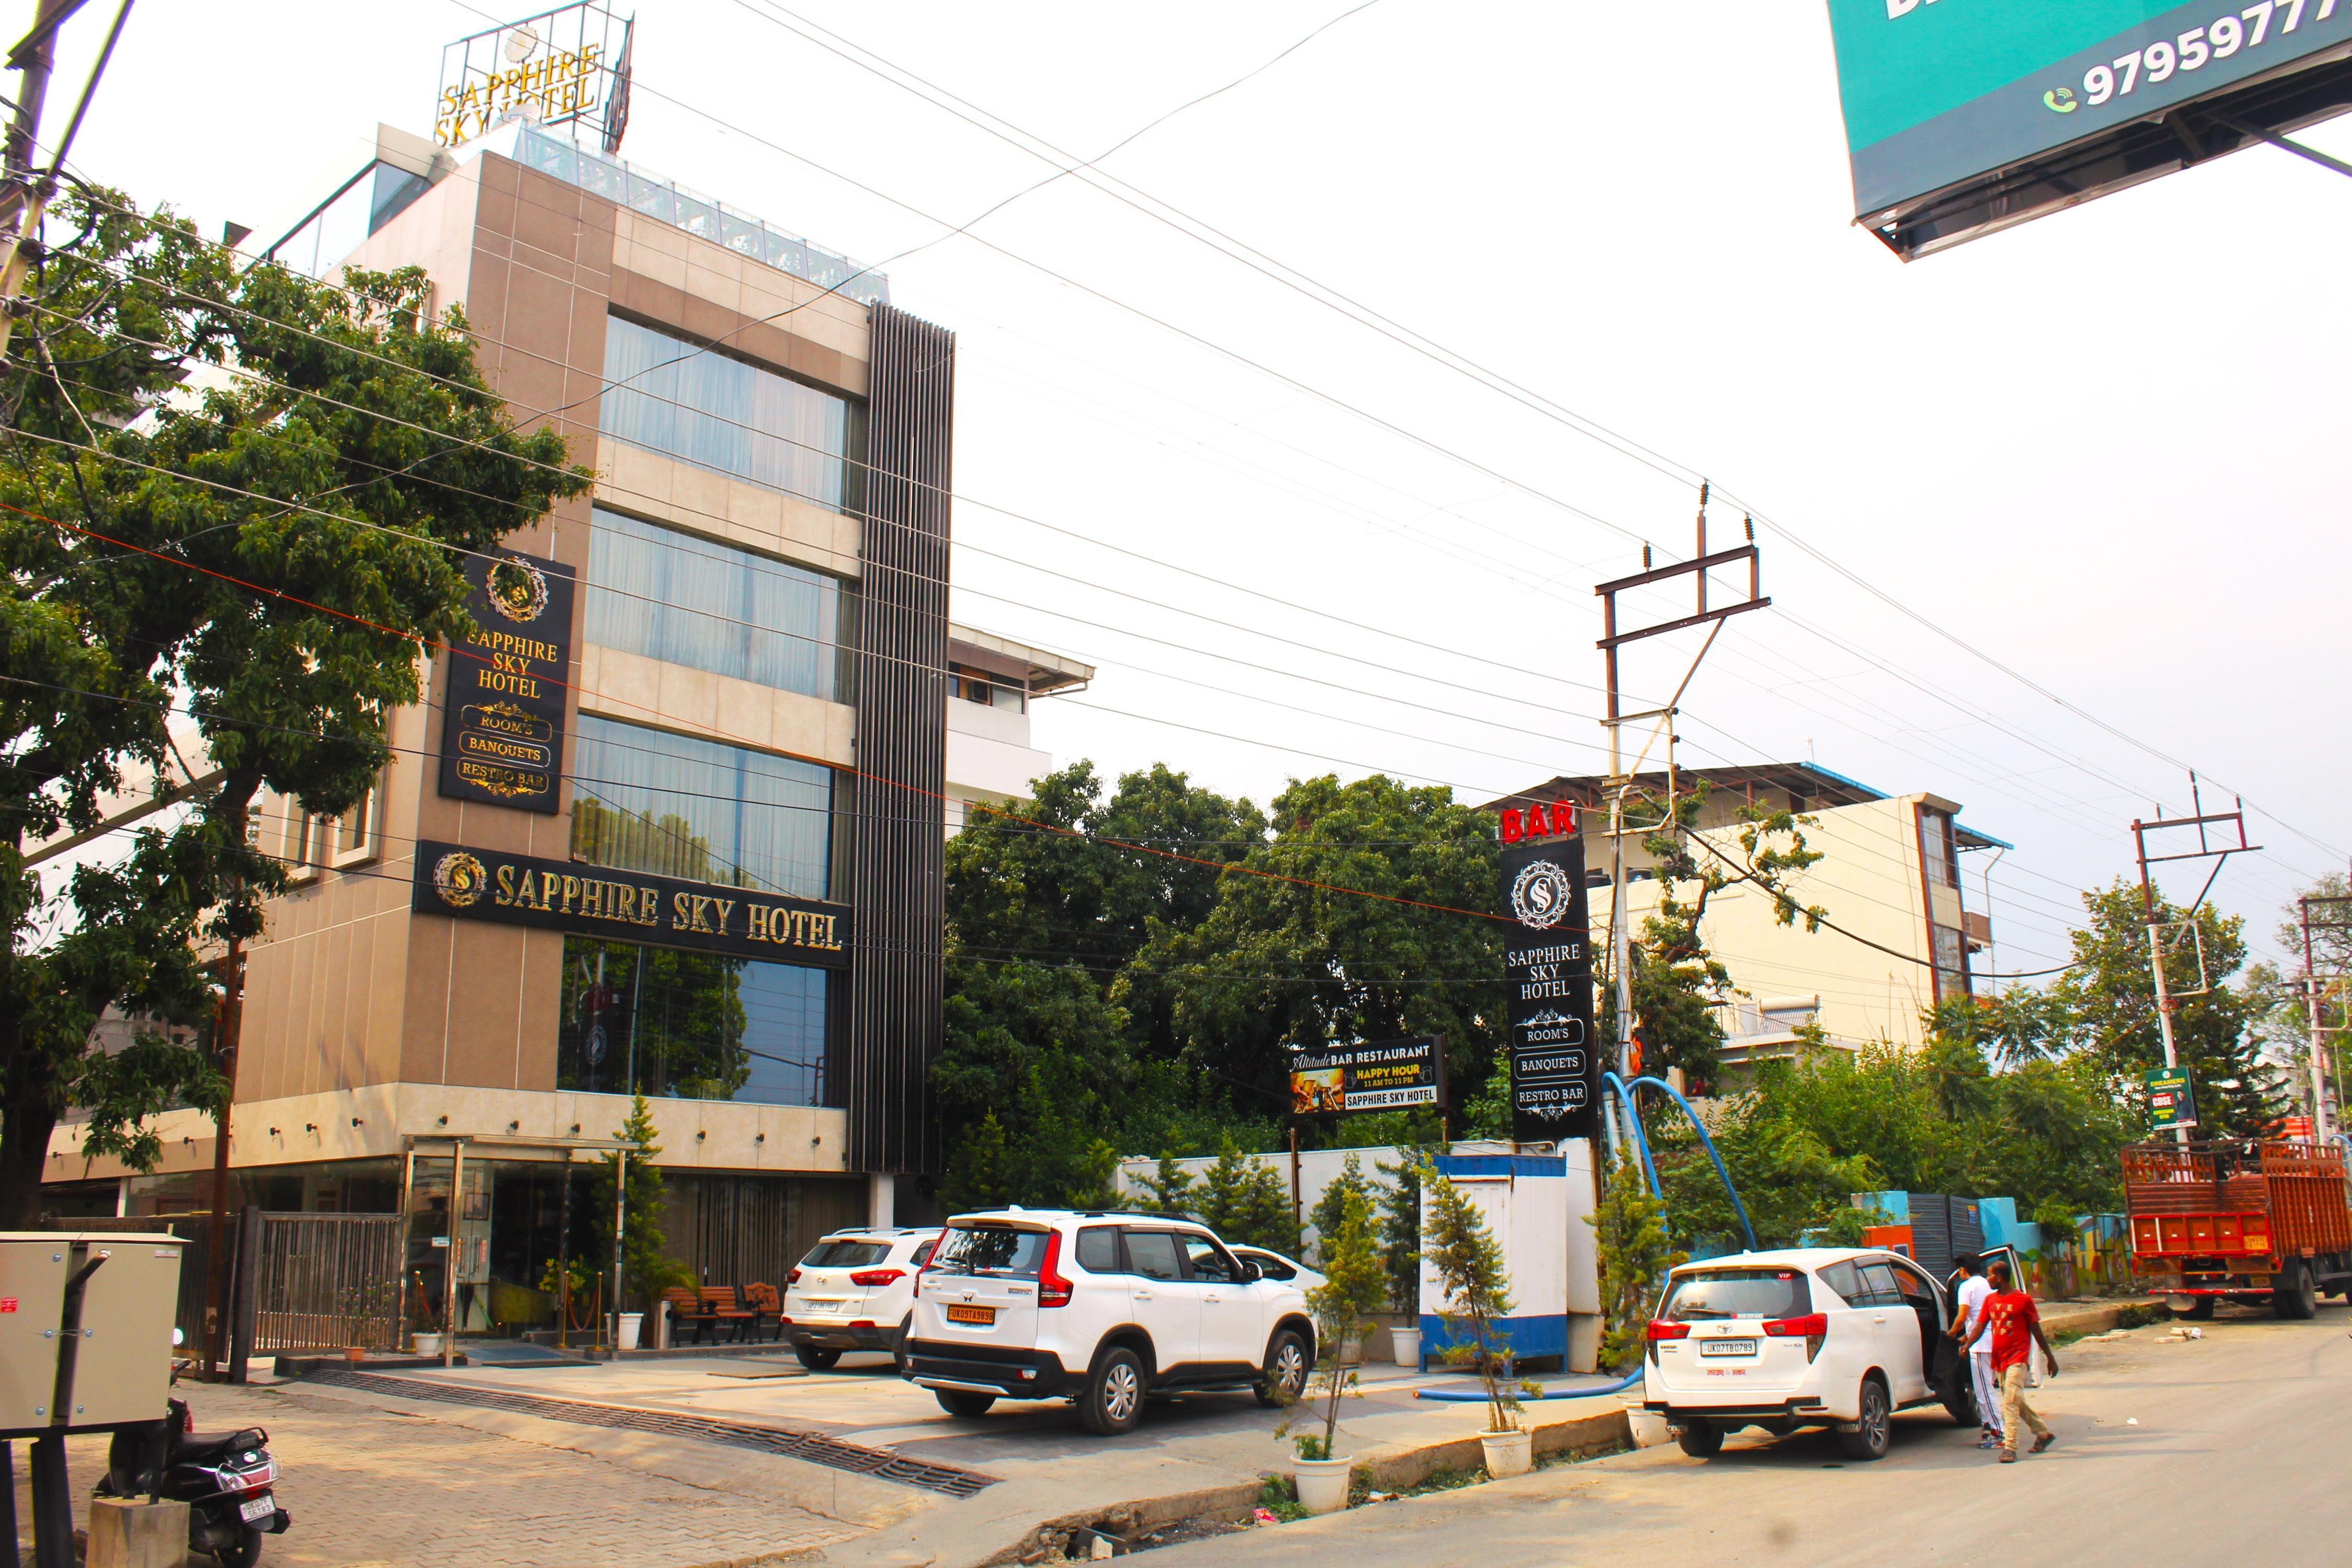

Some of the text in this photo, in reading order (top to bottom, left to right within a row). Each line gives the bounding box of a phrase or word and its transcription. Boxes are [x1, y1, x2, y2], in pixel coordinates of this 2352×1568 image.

[442, 43, 599, 116] SAPPHIRE
[434, 106, 492, 147] SKY
[493, 653, 531, 676] SKY
[478, 669, 540, 699] HOTEL
[481, 716, 533, 735] ROOM'S
[469, 737, 540, 760] BANQUETS
[462, 763, 543, 787] RESTRO BAR
[1502, 800, 1575, 844] BAR
[495, 864, 659, 926] SAPPHIRE
[673, 892, 735, 936] SKY
[747, 904, 843, 951] HOTEL
[1508, 944, 1580, 966] SAPPHIRE
[1530, 964, 1559, 981] SKY
[1521, 981, 1570, 999] HOTEL
[1527, 1028, 1569, 1041] ROOM'S
[1289, 1045, 1429, 1072] Altitude BAR RESTAURANT
[1521, 1057, 1578, 1071] BANQUETS
[1357, 1064, 1420, 1079] HAPPY HOUR
[1347, 1090, 1434, 1106] SAPPHIRE SKY HOTEL
[1519, 1089, 1583, 1102] RESTRO BAR
[952, 1309, 993, 1320] UK09TA9898
[1708, 1343, 1753, 1352] UK07TB0789
